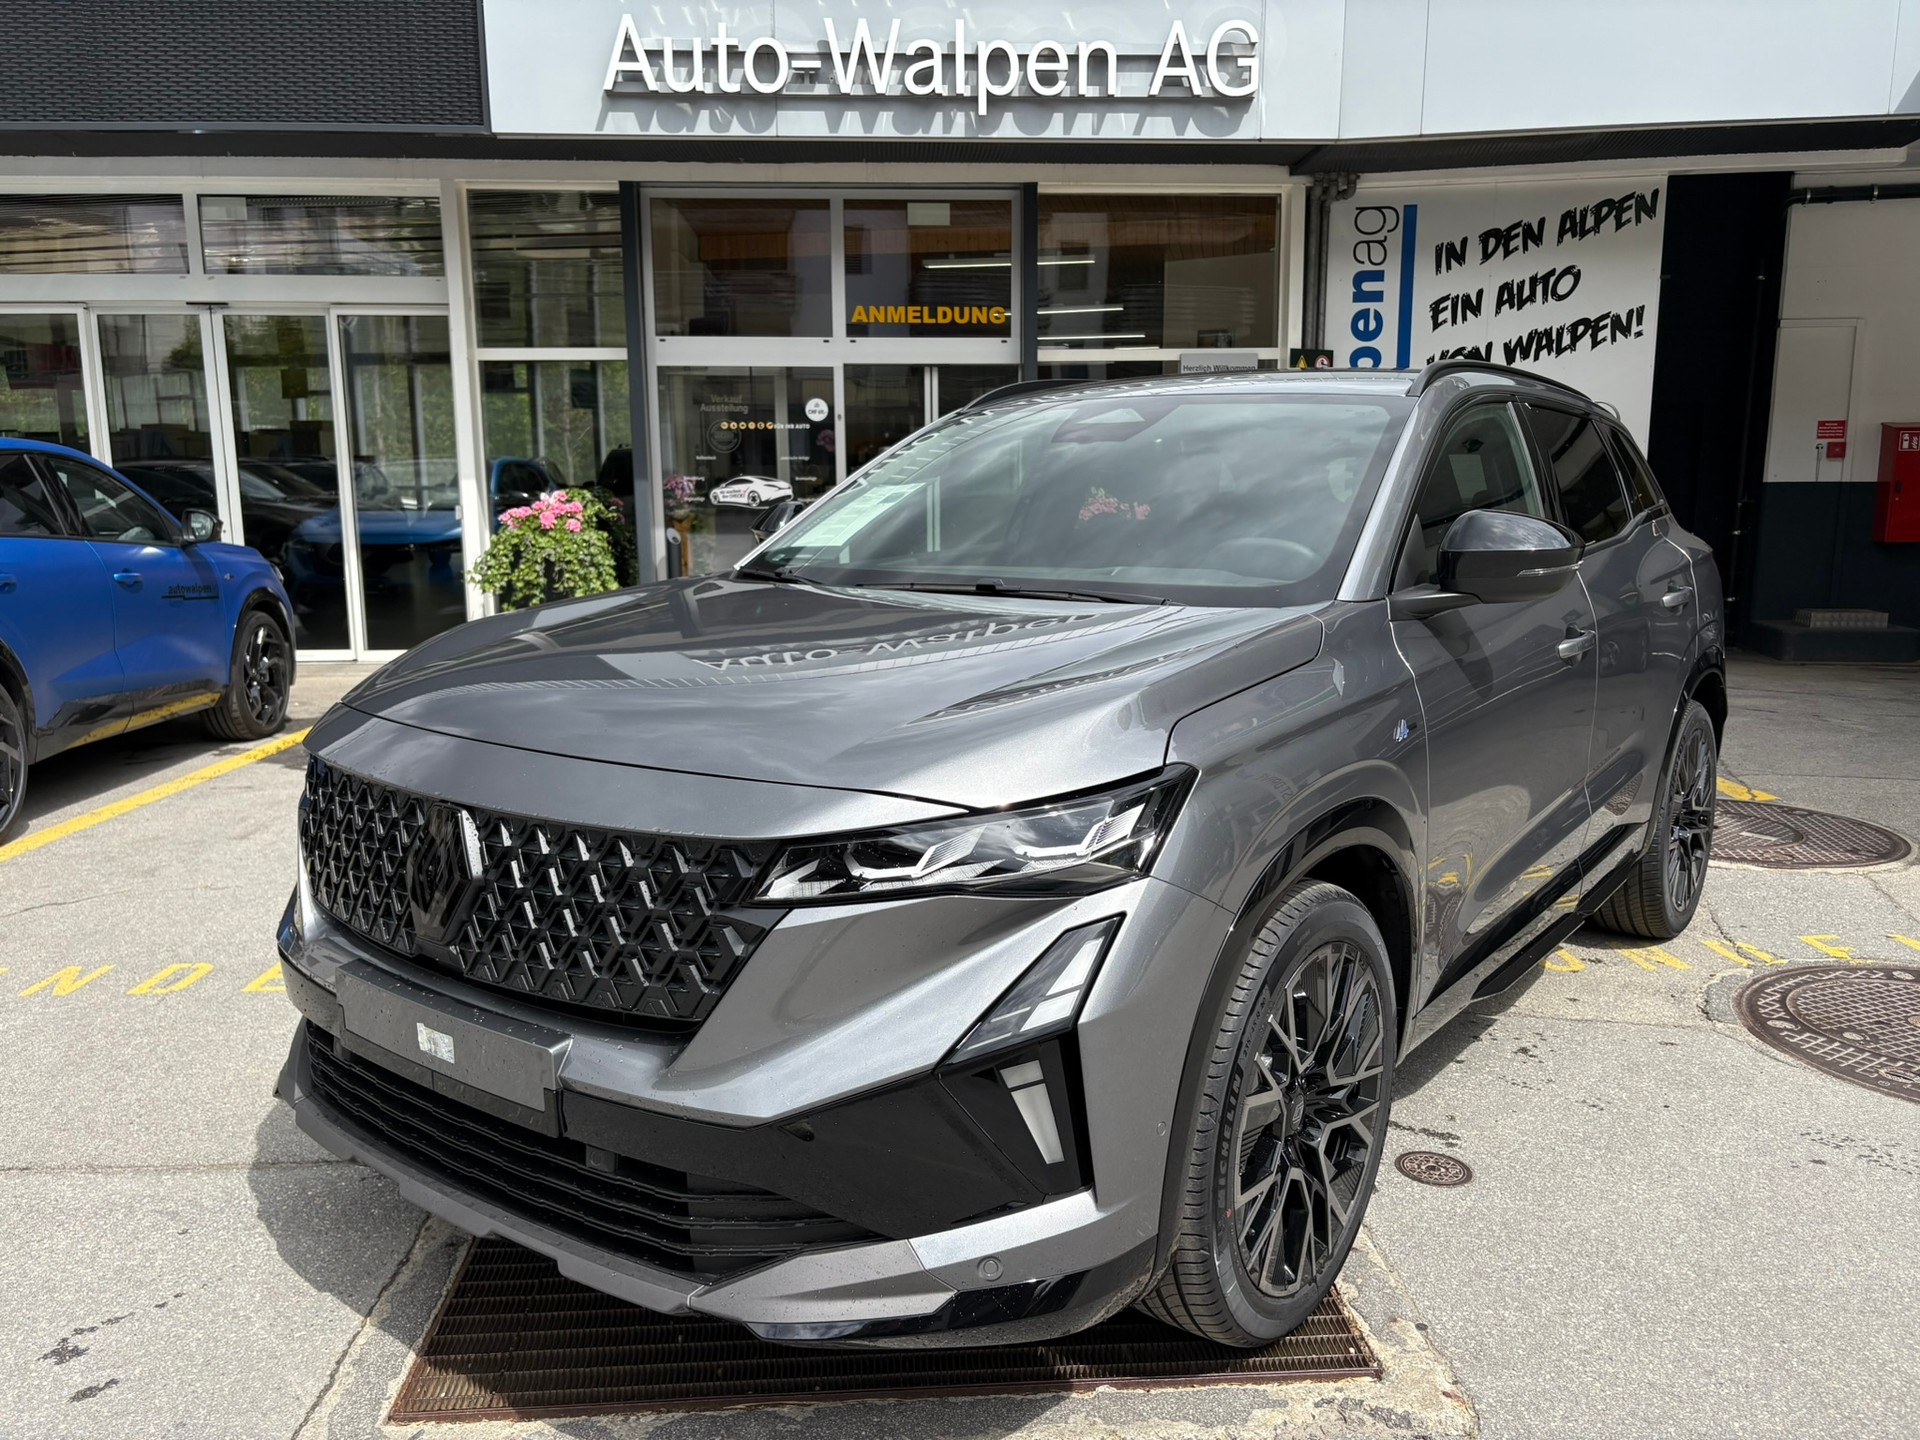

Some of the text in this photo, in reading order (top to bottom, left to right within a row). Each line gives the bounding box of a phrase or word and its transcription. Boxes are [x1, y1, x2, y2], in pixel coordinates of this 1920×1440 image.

[603, 14, 1260, 116] Auto-Walpen AG
[1434, 188, 1660, 276] IN DEN ALPEN
[851, 305, 1006, 324] ANMELDUNG
[1429, 265, 1582, 332] EIN AUTO
[1503, 304, 1646, 367] WALPEN!
[1183, 365, 1212, 373] Herzlich
[700, 403, 749, 415] Ausstellung
[168, 583, 212, 595] autowalpen
[1218, 1078, 1241, 1207] MICHELIN
